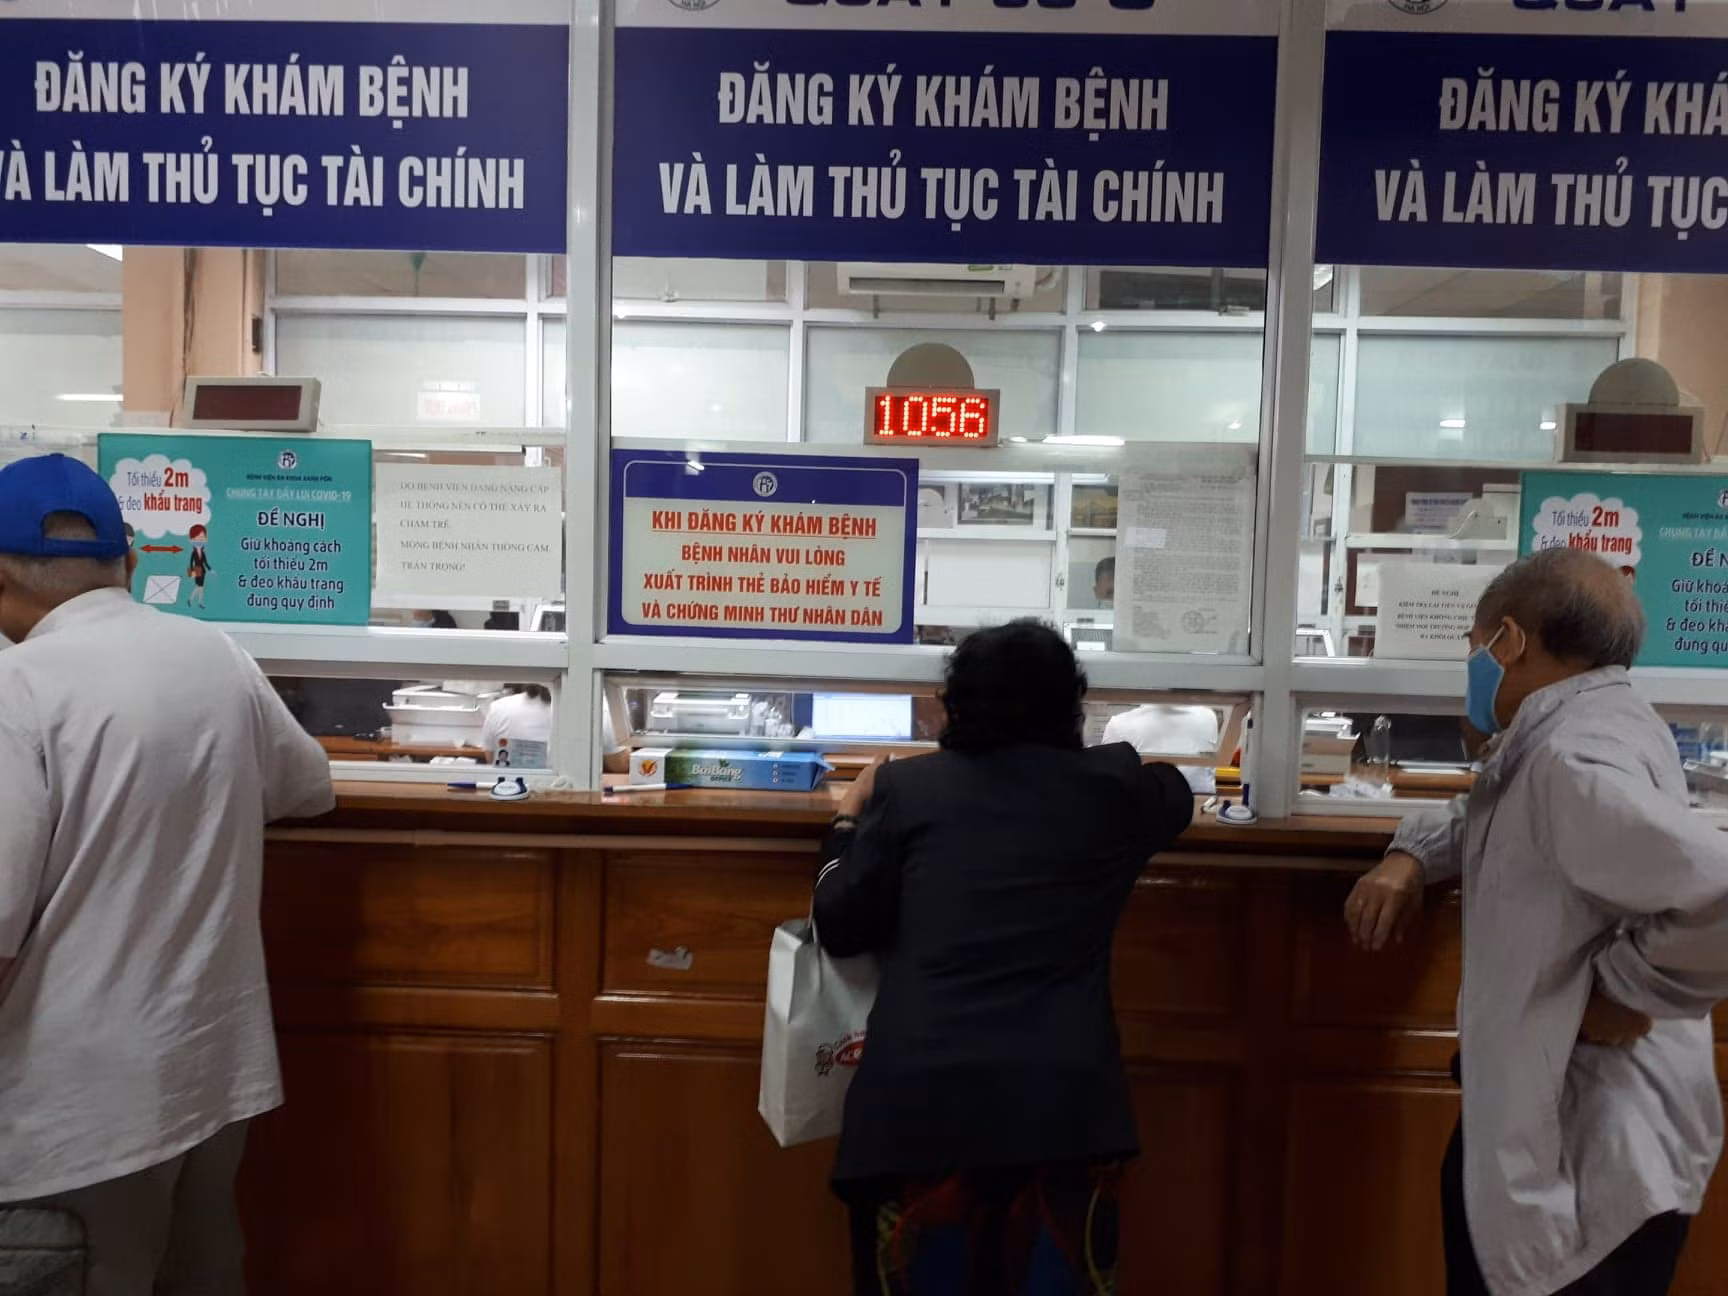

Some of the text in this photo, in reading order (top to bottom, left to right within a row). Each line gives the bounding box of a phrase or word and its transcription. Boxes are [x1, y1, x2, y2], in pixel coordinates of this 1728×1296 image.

[35, 51, 468, 128] ĐĂNG KÝ KHÁM BỆNH
[718, 62, 1168, 140] ĐĂNG KÝ KHÁM BỆNH
[1440, 68, 1559, 132] ĐĂNG
[1575, 70, 1631, 133] KÝ
[0, 136, 524, 216] À LÀM THỦ TỤC TÀI CHÍNH
[659, 149, 1223, 231] VÀ LÀM THỦ TỤC TÀI CHÍNH
[1376, 157, 1728, 240] VÀ LÀM THỦ TỤC
[879, 395, 985, 438] 1056
[127, 467, 189, 488] Tối thiểu 2m
[126, 496, 142, 511] đeo
[144, 489, 170, 511] khẩu
[174, 494, 202, 514] trang
[258, 507, 324, 530] ĐỀ NGHỊ
[652, 508, 877, 539] KHI ĐĂNG KÝ KHÁM BỆNH
[309, 558, 328, 571] 2m
[682, 544, 845, 566] BỆNH NHÂN VUI LÒNG
[1692, 547, 1715, 567] ĐỀ
[238, 574, 247, 588] &
[251, 574, 274, 588] đeo
[311, 578, 344, 594] trang
[644, 569, 882, 597] XUẤT TRÌNH THẺ BẢO HIỂM Y TẾ
[642, 600, 883, 627] VÀ CHỨNG MINH THƯ NHÂN DÂN
[1666, 617, 1676, 631] &
[1680, 617, 1704, 632] đeo
